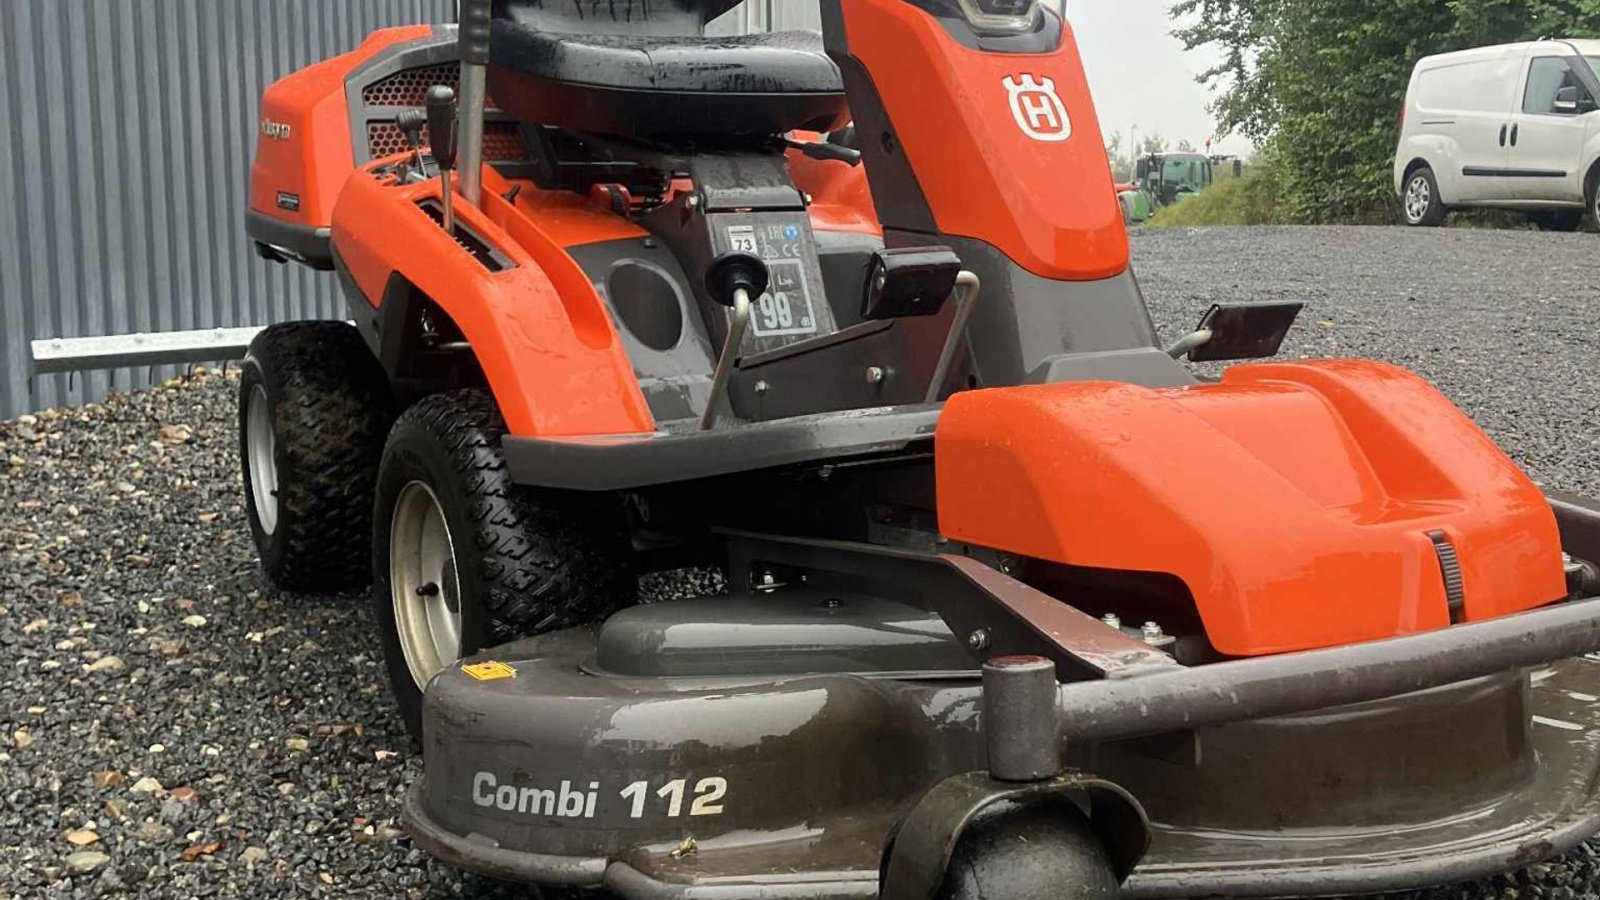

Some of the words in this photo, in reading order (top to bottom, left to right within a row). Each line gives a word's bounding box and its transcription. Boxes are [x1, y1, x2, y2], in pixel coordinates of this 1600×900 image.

[734, 239, 752, 251] 73
[472, 771, 599, 818] Combi
[619, 776, 728, 818] 112
